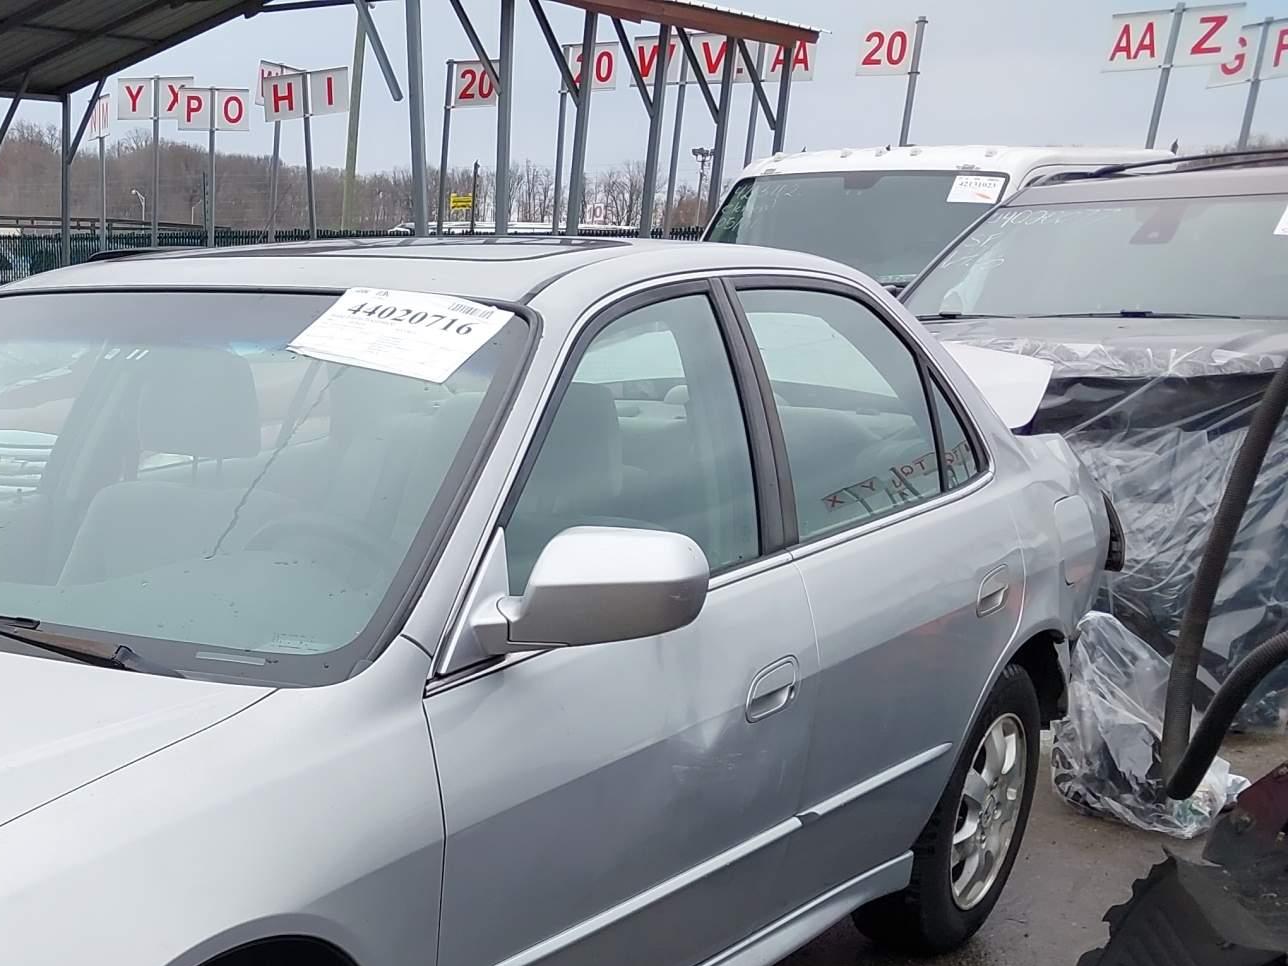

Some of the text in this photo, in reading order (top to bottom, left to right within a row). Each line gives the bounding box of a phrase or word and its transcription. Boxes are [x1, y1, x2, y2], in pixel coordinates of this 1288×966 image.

[861, 31, 907, 65] 20
[1109, 22, 1155, 61] AA
[1190, 15, 1228, 55] Z
[702, 41, 727, 73] V
[125, 85, 144, 112] Y
[273, 82, 293, 112] H
[459, 69, 493, 99] 20
[187, 95, 203, 122] P
[347, 302, 480, 335] 44020716
